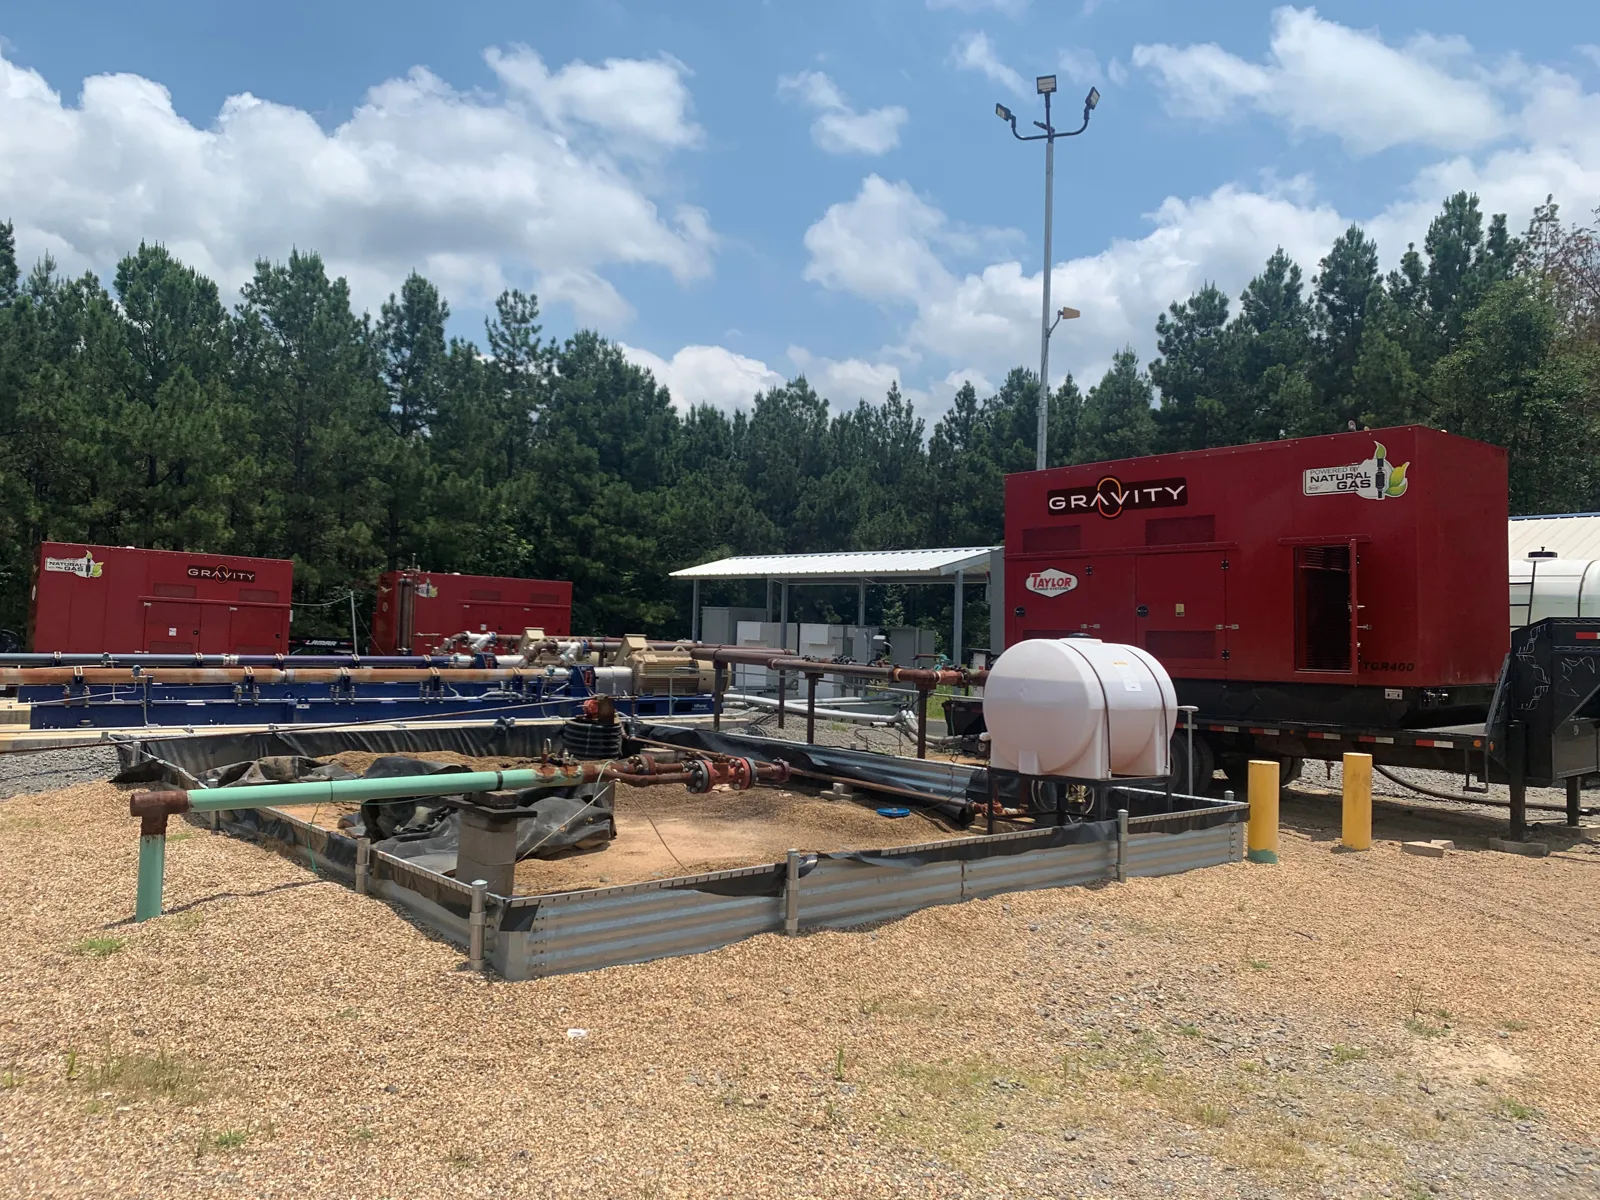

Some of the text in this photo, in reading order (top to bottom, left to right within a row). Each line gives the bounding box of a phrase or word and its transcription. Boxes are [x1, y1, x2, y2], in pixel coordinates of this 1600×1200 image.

[1310, 467, 1348, 475] POWERED
[1310, 472, 1372, 483] NATURAL
[1336, 479, 1372, 490] GAS
[1048, 485, 1186, 510] GRAVITY
[188, 568, 255, 580] GRAVITY
[1031, 573, 1072, 588] TAYLOR
[1363, 661, 1415, 672] TGR400
